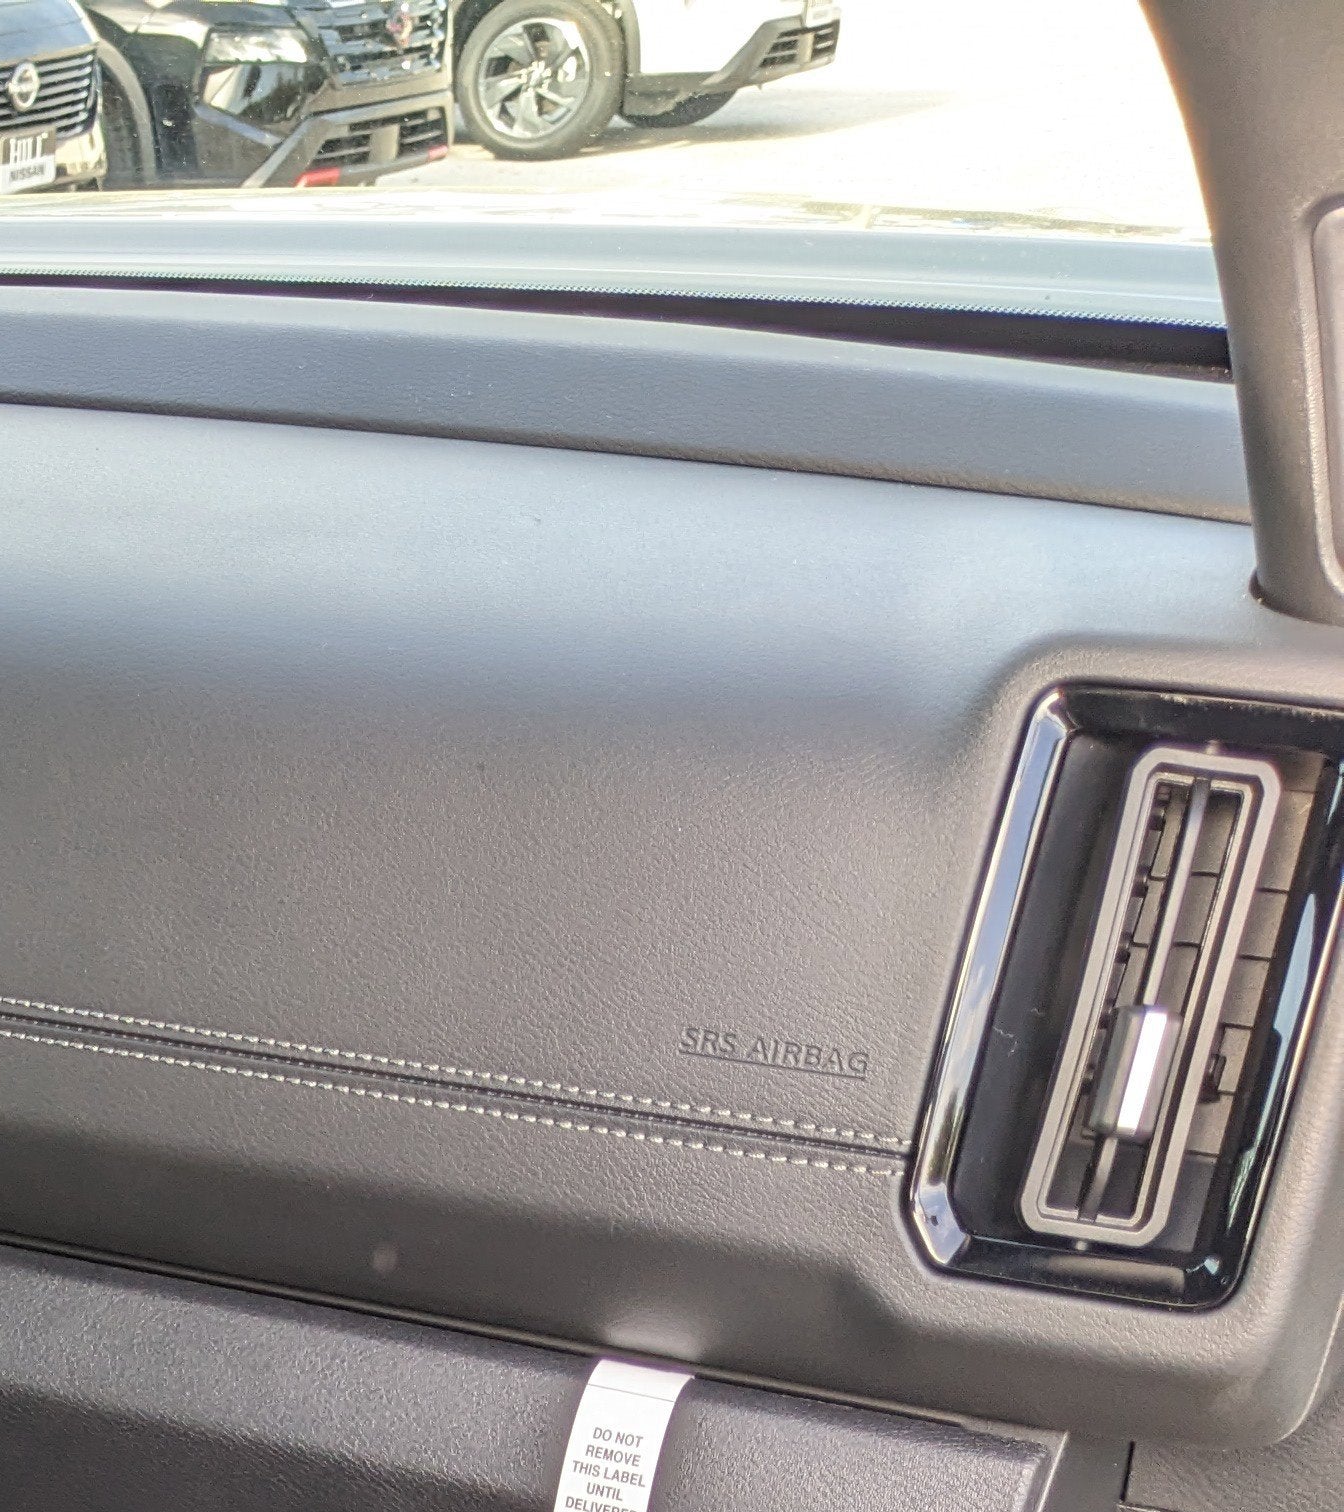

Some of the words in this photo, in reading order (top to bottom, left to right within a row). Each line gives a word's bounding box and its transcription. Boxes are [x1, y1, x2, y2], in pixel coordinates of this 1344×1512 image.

[679, 1027, 738, 1054] SRS
[747, 1037, 869, 1076] AIRBAG
[593, 1427, 612, 1441] DO
[615, 1431, 643, 1448] NOT
[585, 1444, 641, 1467] REMOVE
[572, 1460, 600, 1478] THIS
[603, 1466, 646, 1487] LABEL
[586, 1482, 623, 1501] UNTIL
